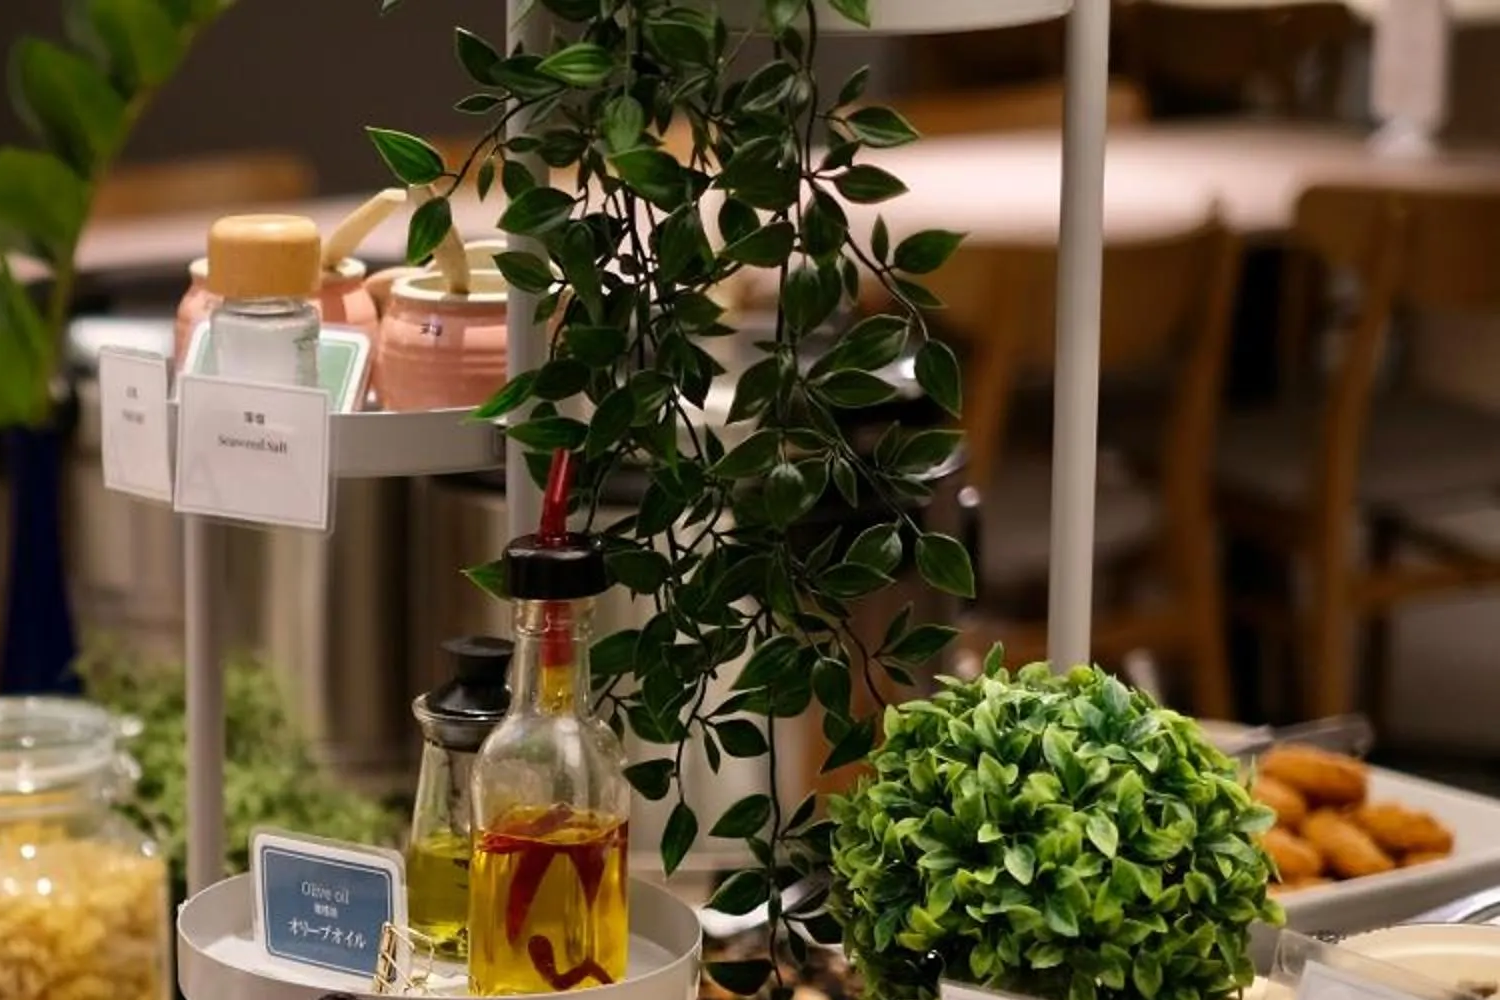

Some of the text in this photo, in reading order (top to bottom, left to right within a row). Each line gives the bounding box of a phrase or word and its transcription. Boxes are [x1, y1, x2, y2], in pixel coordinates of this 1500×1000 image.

[266, 440, 288, 454] Salt
[301, 881, 350, 905] Olive oil
